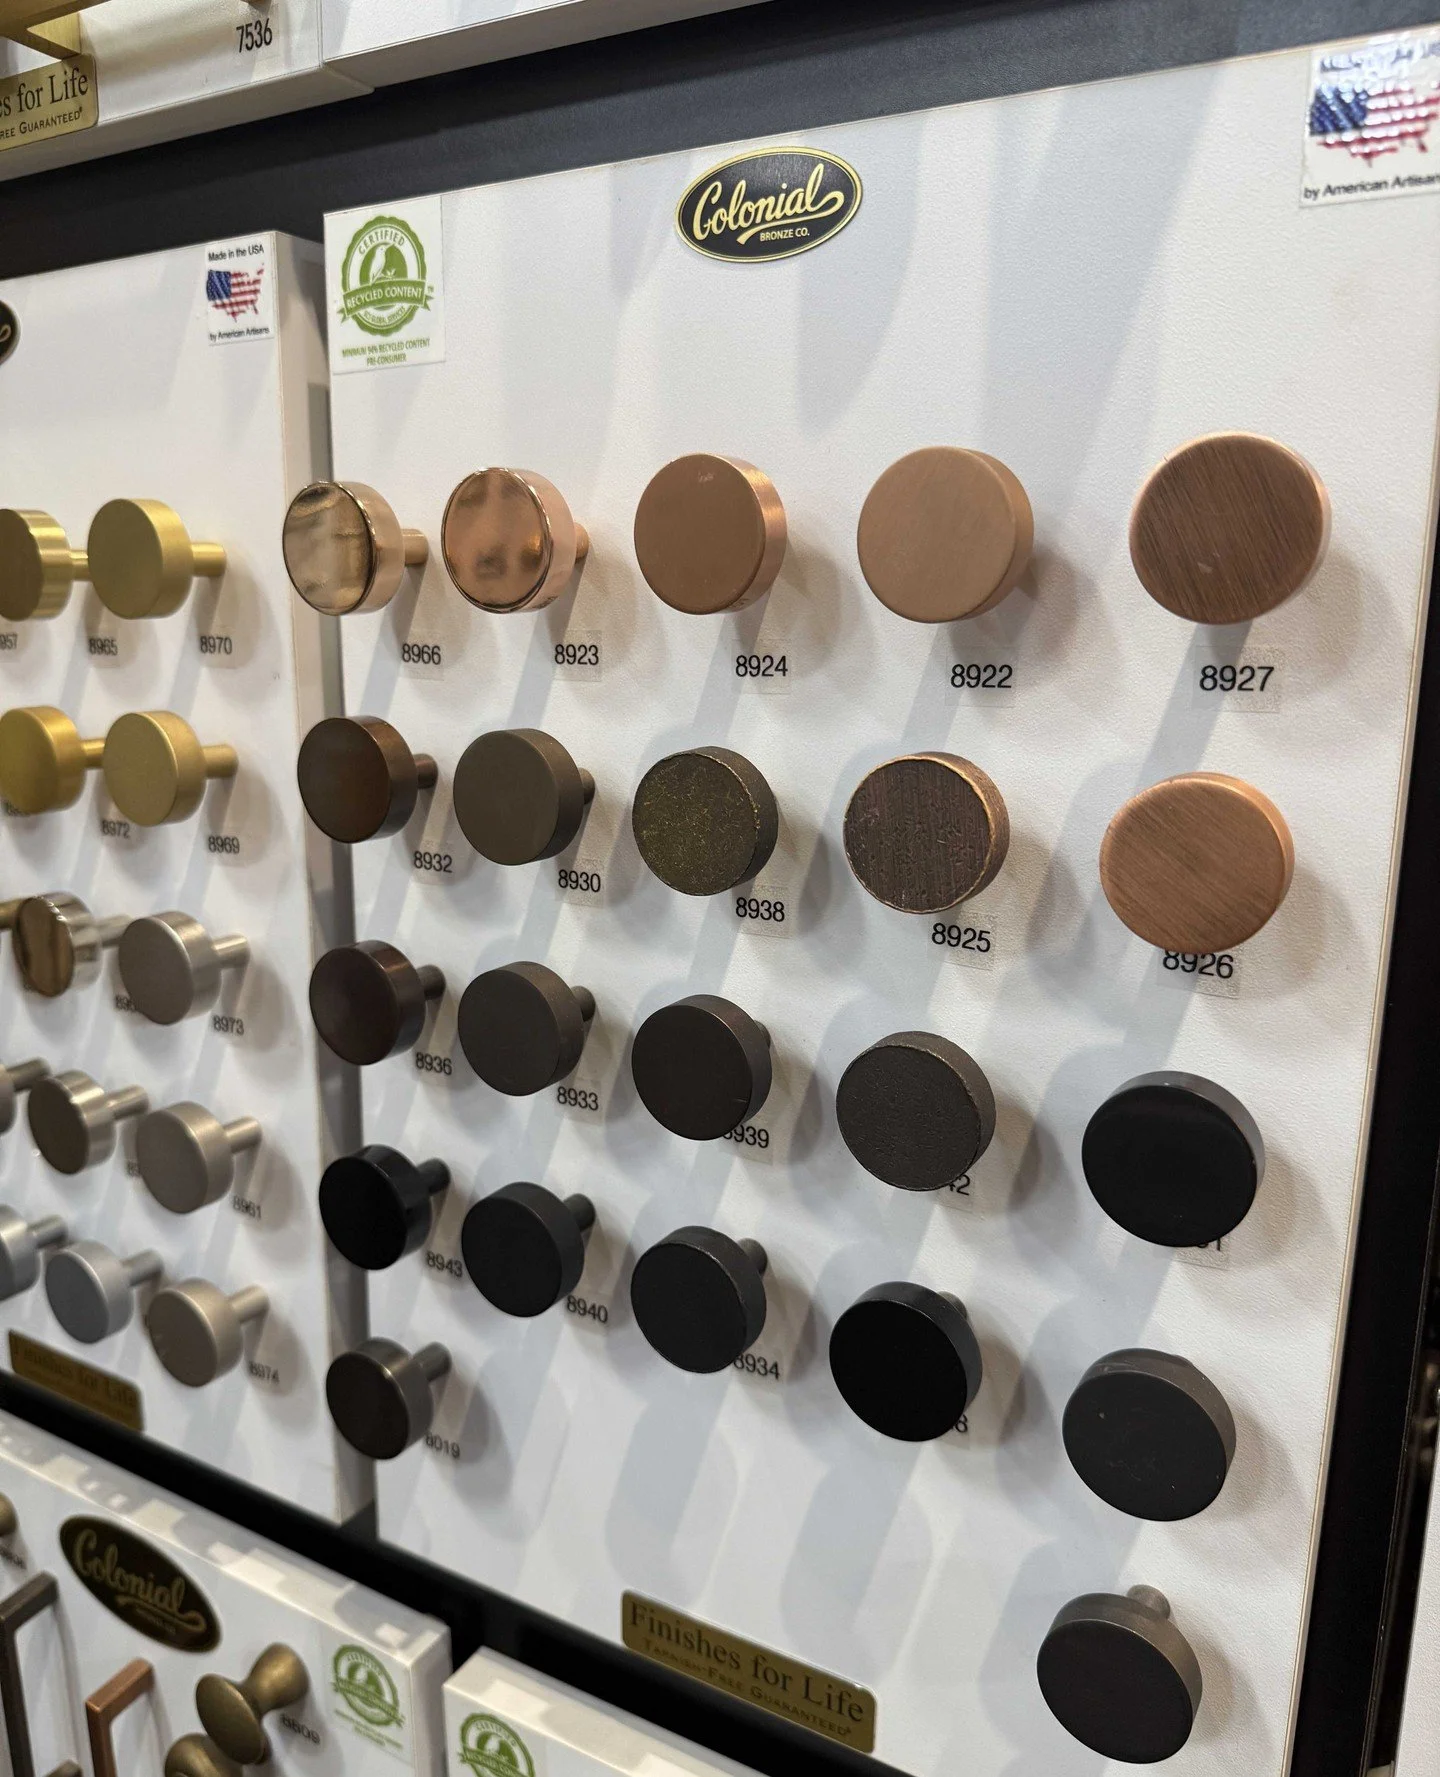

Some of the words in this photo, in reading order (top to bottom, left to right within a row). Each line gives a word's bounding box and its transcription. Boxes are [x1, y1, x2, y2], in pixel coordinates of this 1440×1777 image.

[235, 18, 273, 53] 7536
[0, 95, 11, 117] s
[18, 83, 43, 113] for
[48, 67, 89, 104] Life
[1304, 186, 1320, 200] by
[1323, 178, 1389, 196] American
[693, 163, 844, 244] Colonial
[358, 229, 406, 255] CERTIFIED
[760, 229, 793, 242] BRONZE
[795, 227, 810, 237] CO.
[208, 252, 227, 261] Made
[228, 249, 235, 259] in
[236, 247, 247, 257] the
[248, 244, 264, 255] USA
[347, 289, 384, 308] RECYCLED
[384, 285, 423, 300] CONTENT
[218, 328, 245, 339] American
[405, 338, 430, 350] CONTENT
[200, 635, 233, 655] 8970
[402, 643, 441, 665] 8966
[554, 644, 600, 666] 8923
[735, 655, 788, 677] 8924
[950, 663, 1013, 689] 8922
[1199, 665, 1275, 692] 8927
[413, 850, 453, 873] 8932
[558, 869, 601, 893] 8930
[735, 897, 786, 922] 8938
[931, 922, 991, 953] 8925
[1163, 950, 1235, 979] 8926
[212, 1014, 245, 1035] 8973
[415, 1051, 452, 1076] 8936
[556, 1086, 599, 1111] 8933
[426, 1251, 463, 1278] 8943
[566, 1295, 608, 1324] 8940
[734, 1353, 780, 1380] 8934
[75, 1529, 206, 1632] Colonial
[630, 1601, 741, 1671] Finishes
[752, 1653, 793, 1692] for
[803, 1677, 864, 1723] Life
